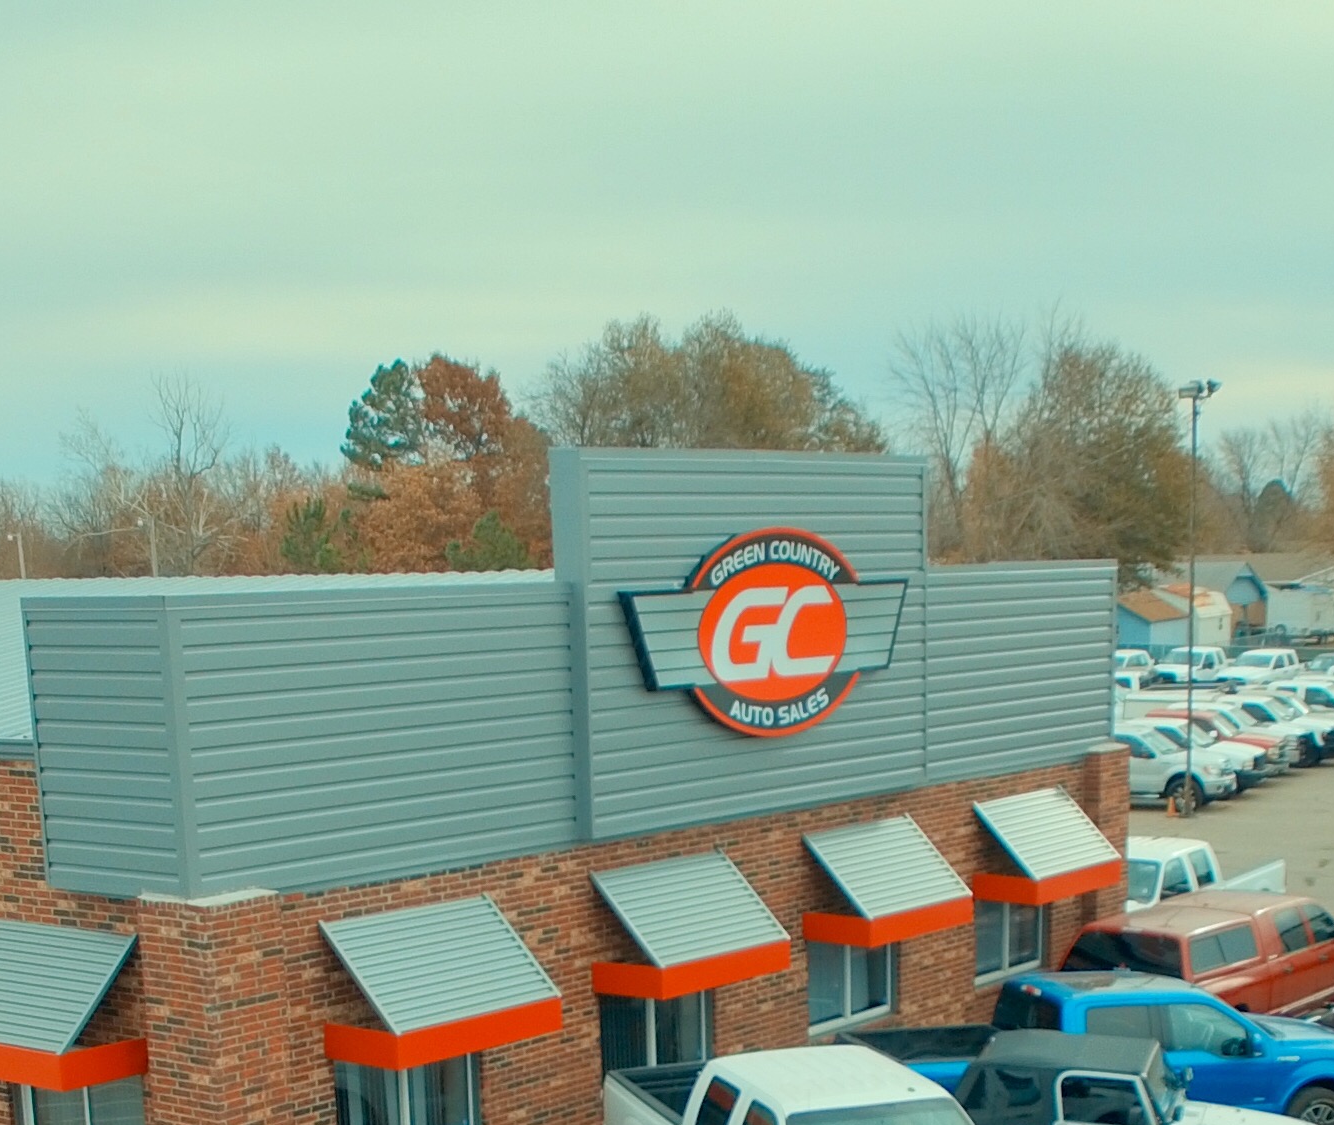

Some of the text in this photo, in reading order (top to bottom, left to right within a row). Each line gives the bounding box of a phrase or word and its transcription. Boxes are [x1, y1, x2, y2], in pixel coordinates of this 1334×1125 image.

[709, 540, 841, 587] GREEN COUNTRY
[711, 585, 836, 682] GC
[729, 687, 830, 726] AUTO SALES
